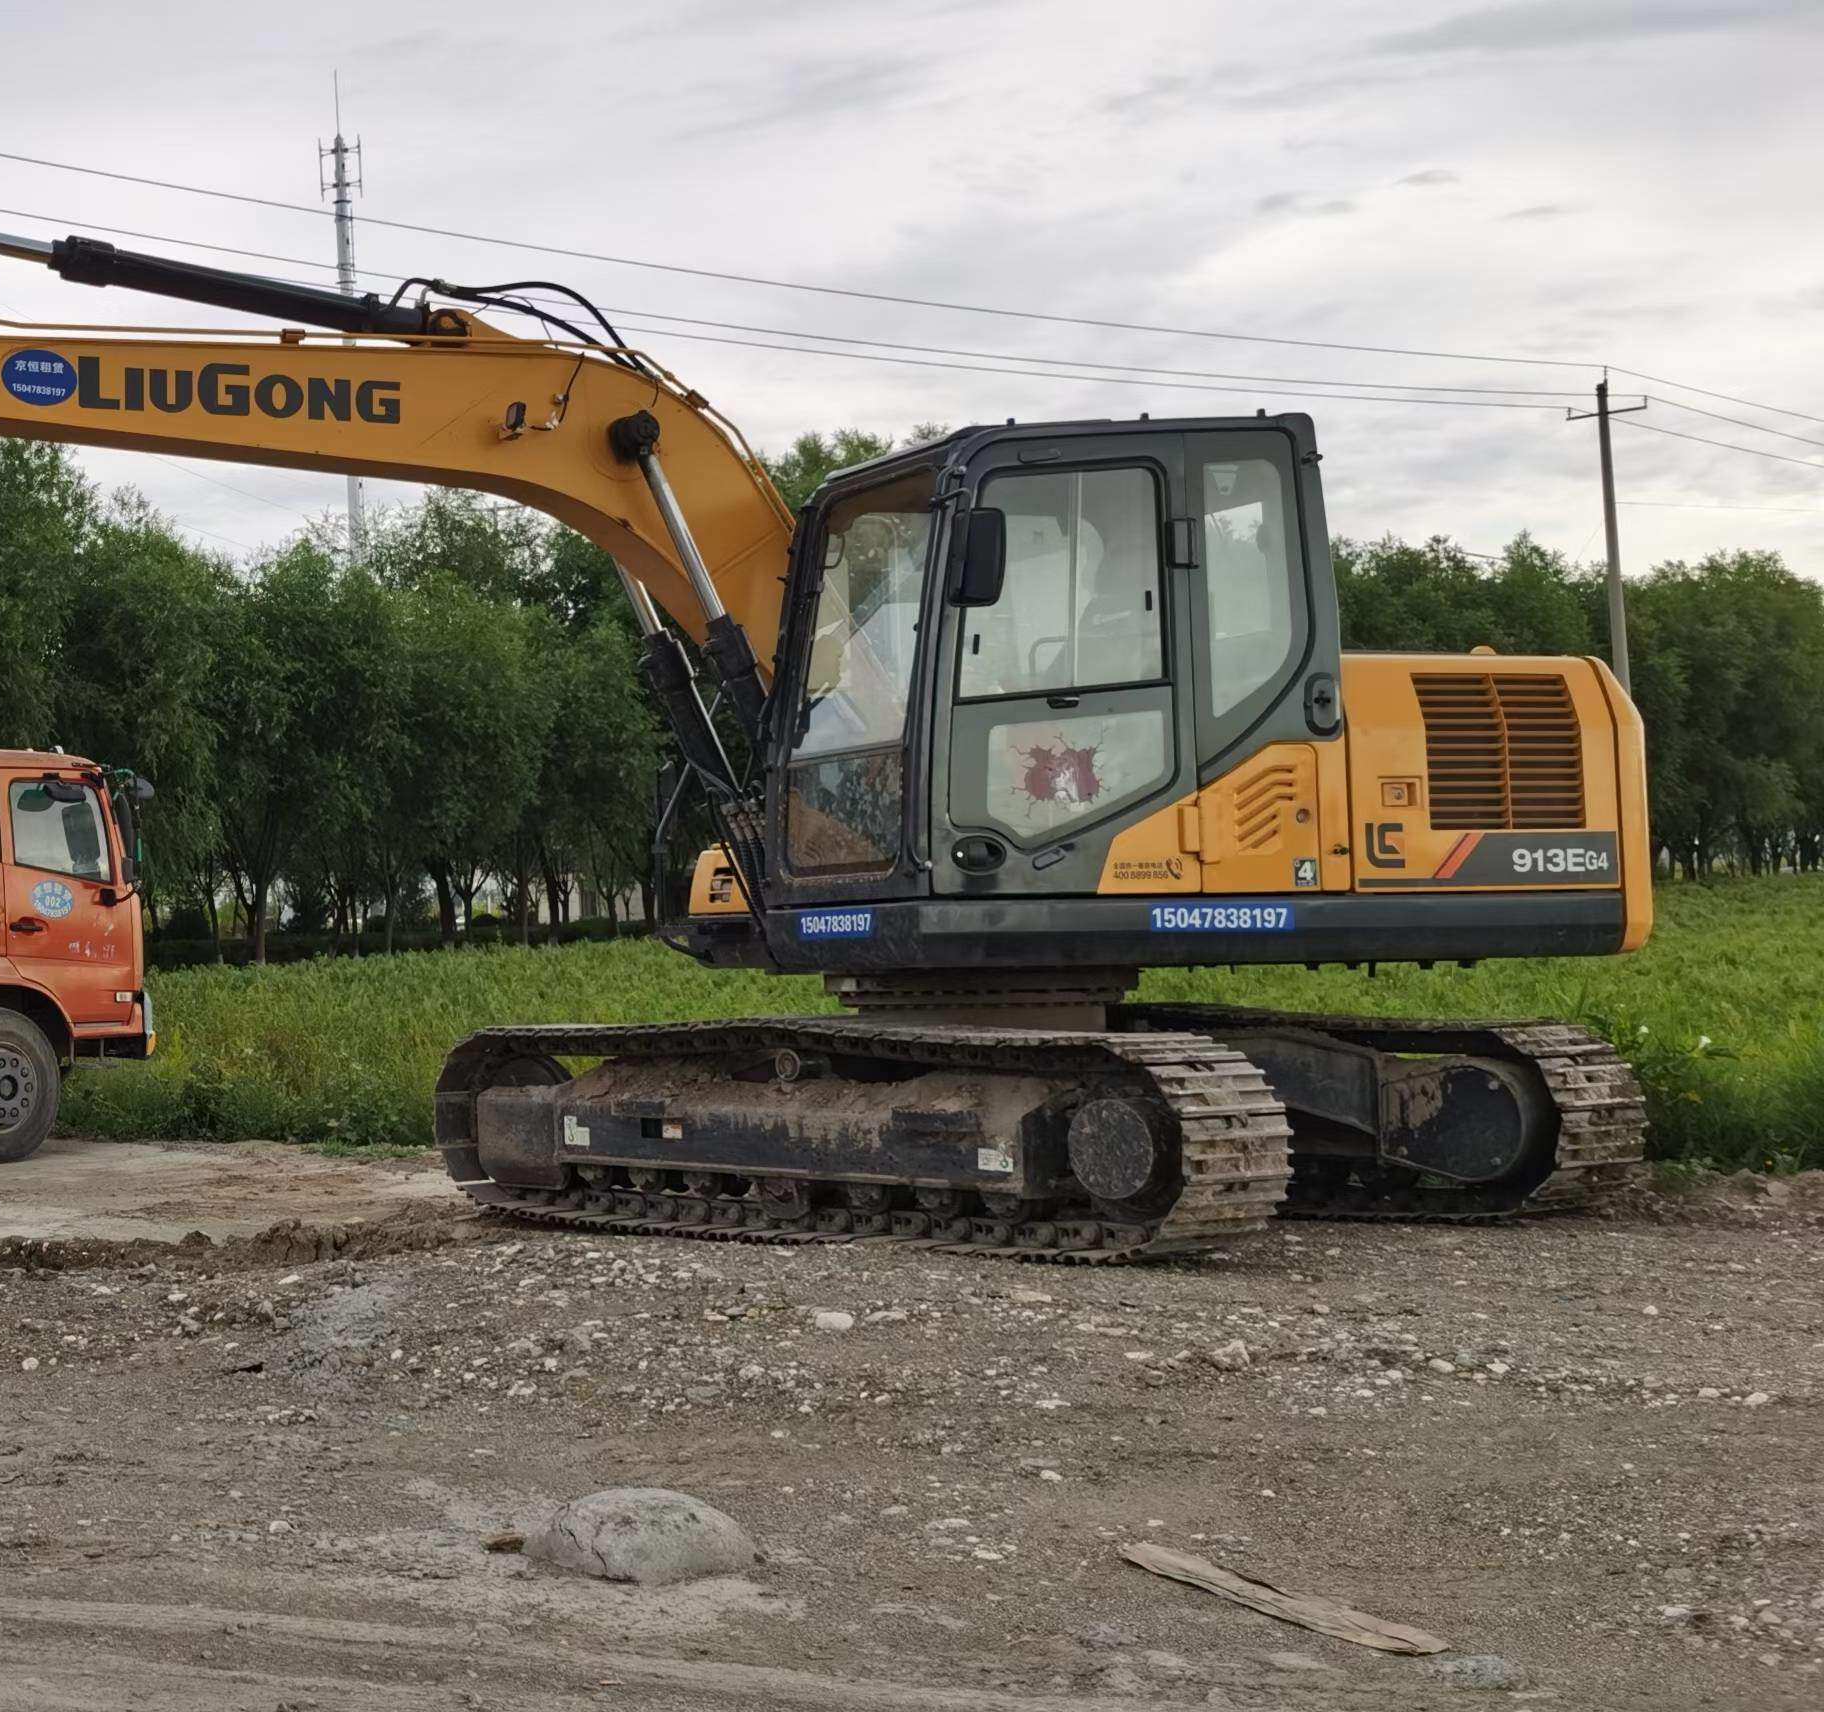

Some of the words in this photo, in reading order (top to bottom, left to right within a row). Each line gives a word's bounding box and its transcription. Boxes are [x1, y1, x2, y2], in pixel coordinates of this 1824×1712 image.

[12, 383, 66, 397] 15047838197
[801, 913, 871, 934] 15047838197
[1152, 908, 1288, 928] 15047838197
